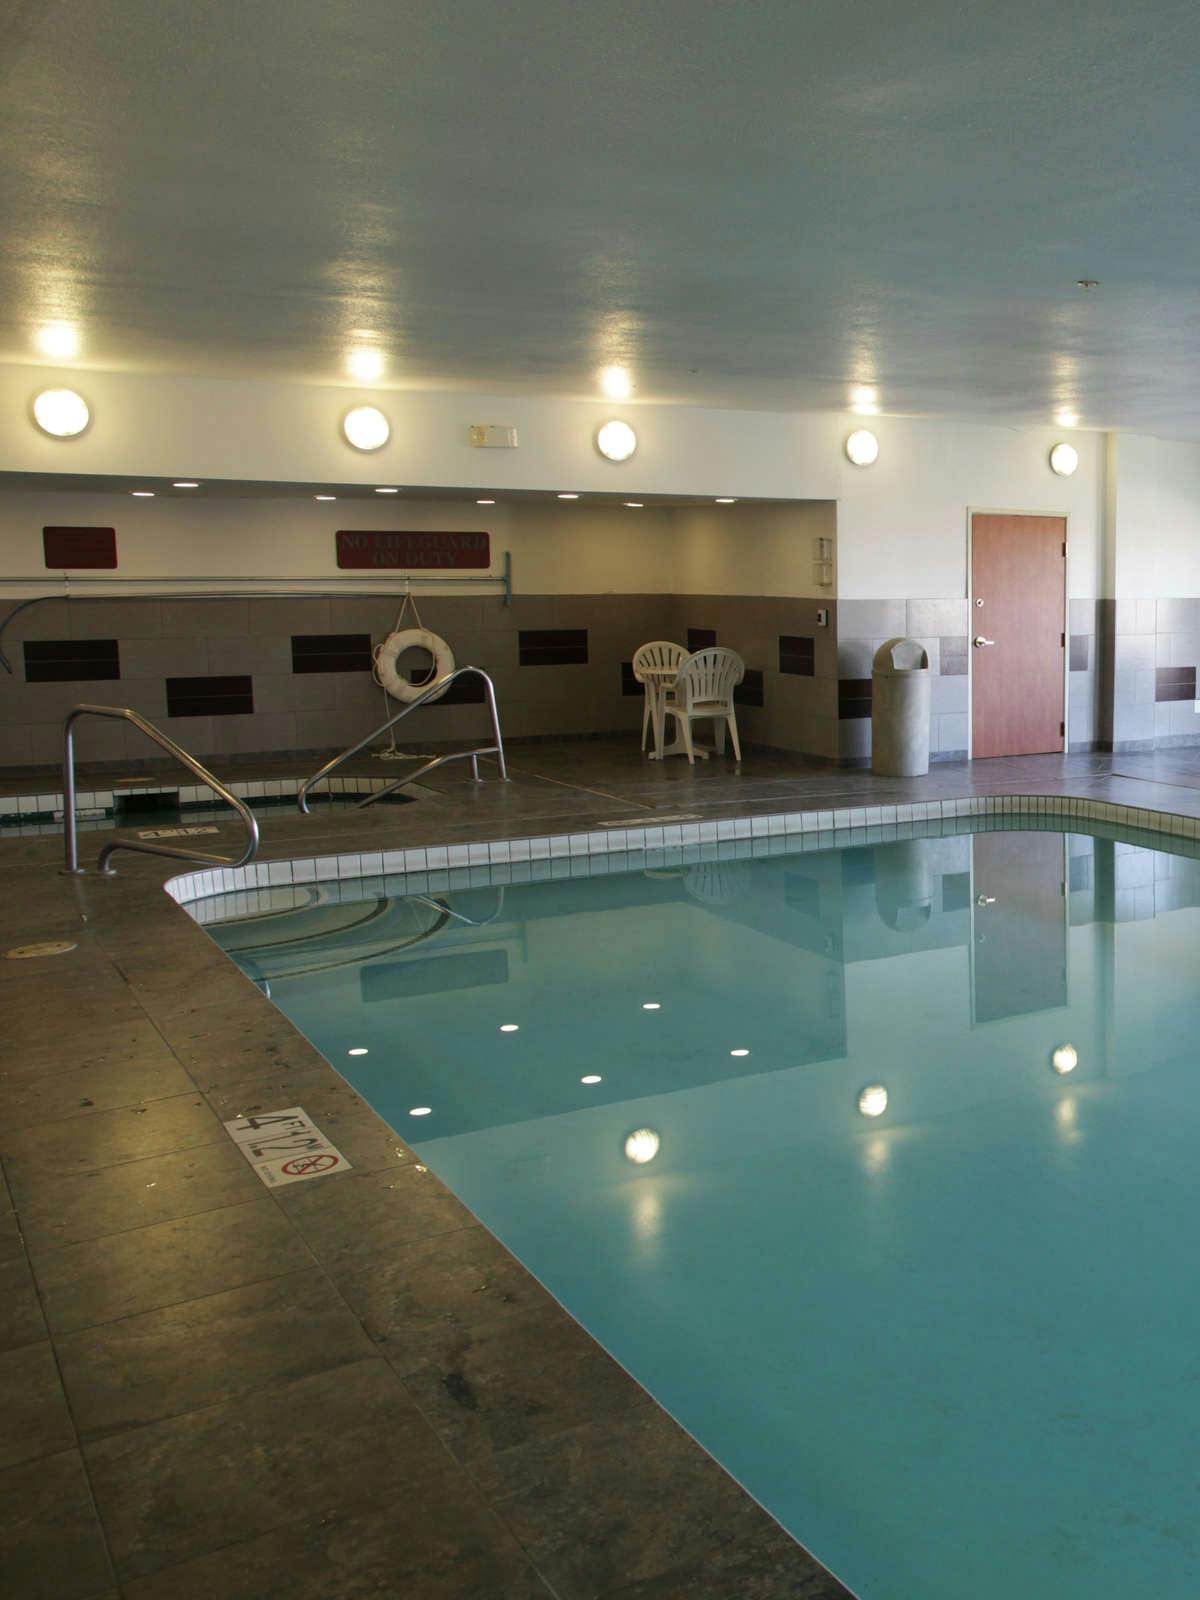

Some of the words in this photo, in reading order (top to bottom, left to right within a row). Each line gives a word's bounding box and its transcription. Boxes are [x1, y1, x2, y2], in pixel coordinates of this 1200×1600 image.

[343, 535, 369, 549] NO
[375, 535, 487, 550] LIFEGUARD
[373, 551, 399, 566] ON
[406, 551, 457, 566] DUTY
